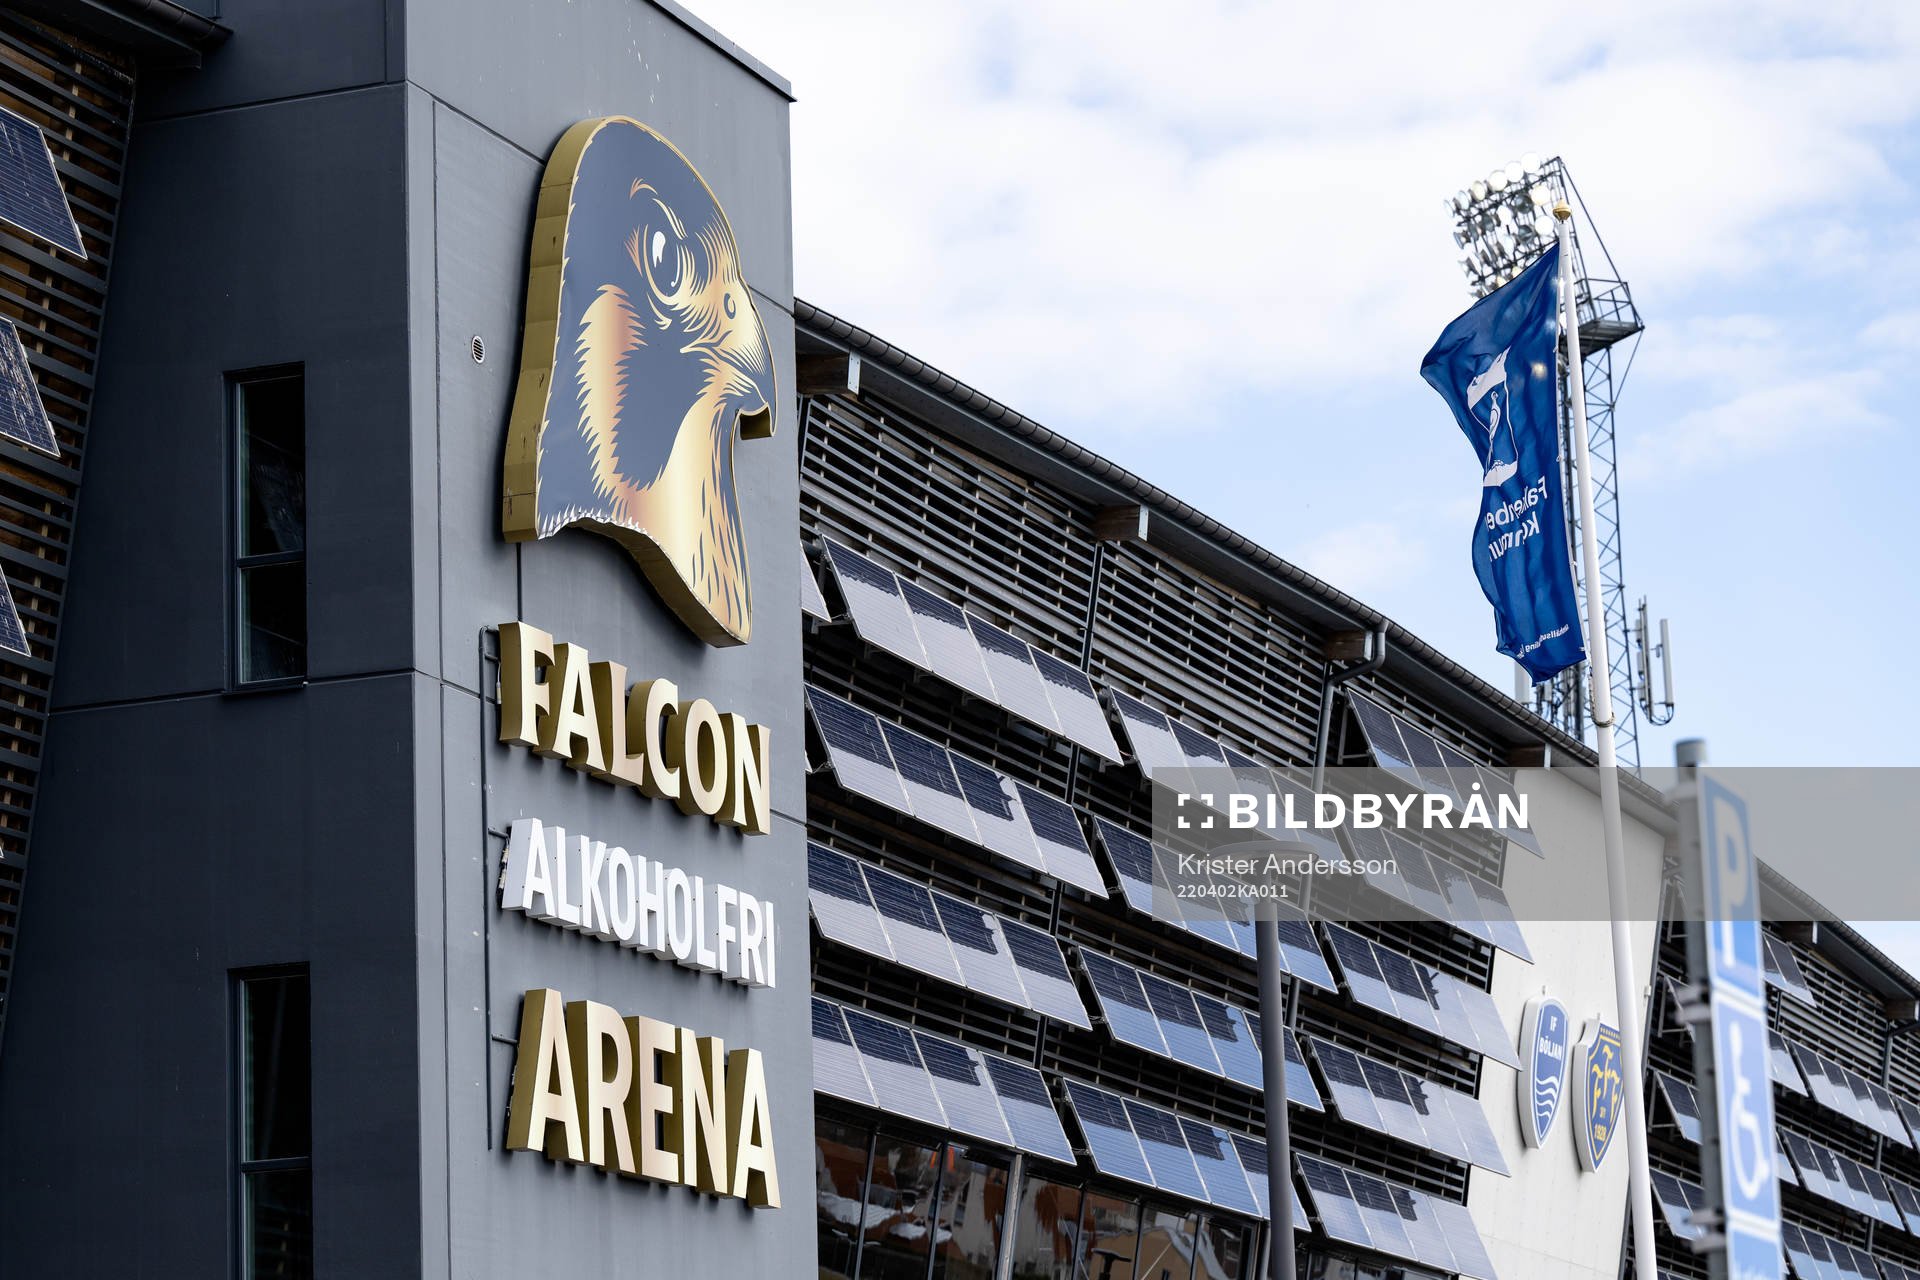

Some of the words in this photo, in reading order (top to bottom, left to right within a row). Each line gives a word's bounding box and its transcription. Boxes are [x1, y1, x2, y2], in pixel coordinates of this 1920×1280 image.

[514, 622, 771, 835] FALCON
[519, 818, 776, 989] ALKOHOLFRI
[1713, 796, 1748, 969] P
[524, 989, 782, 1209] ARENA
